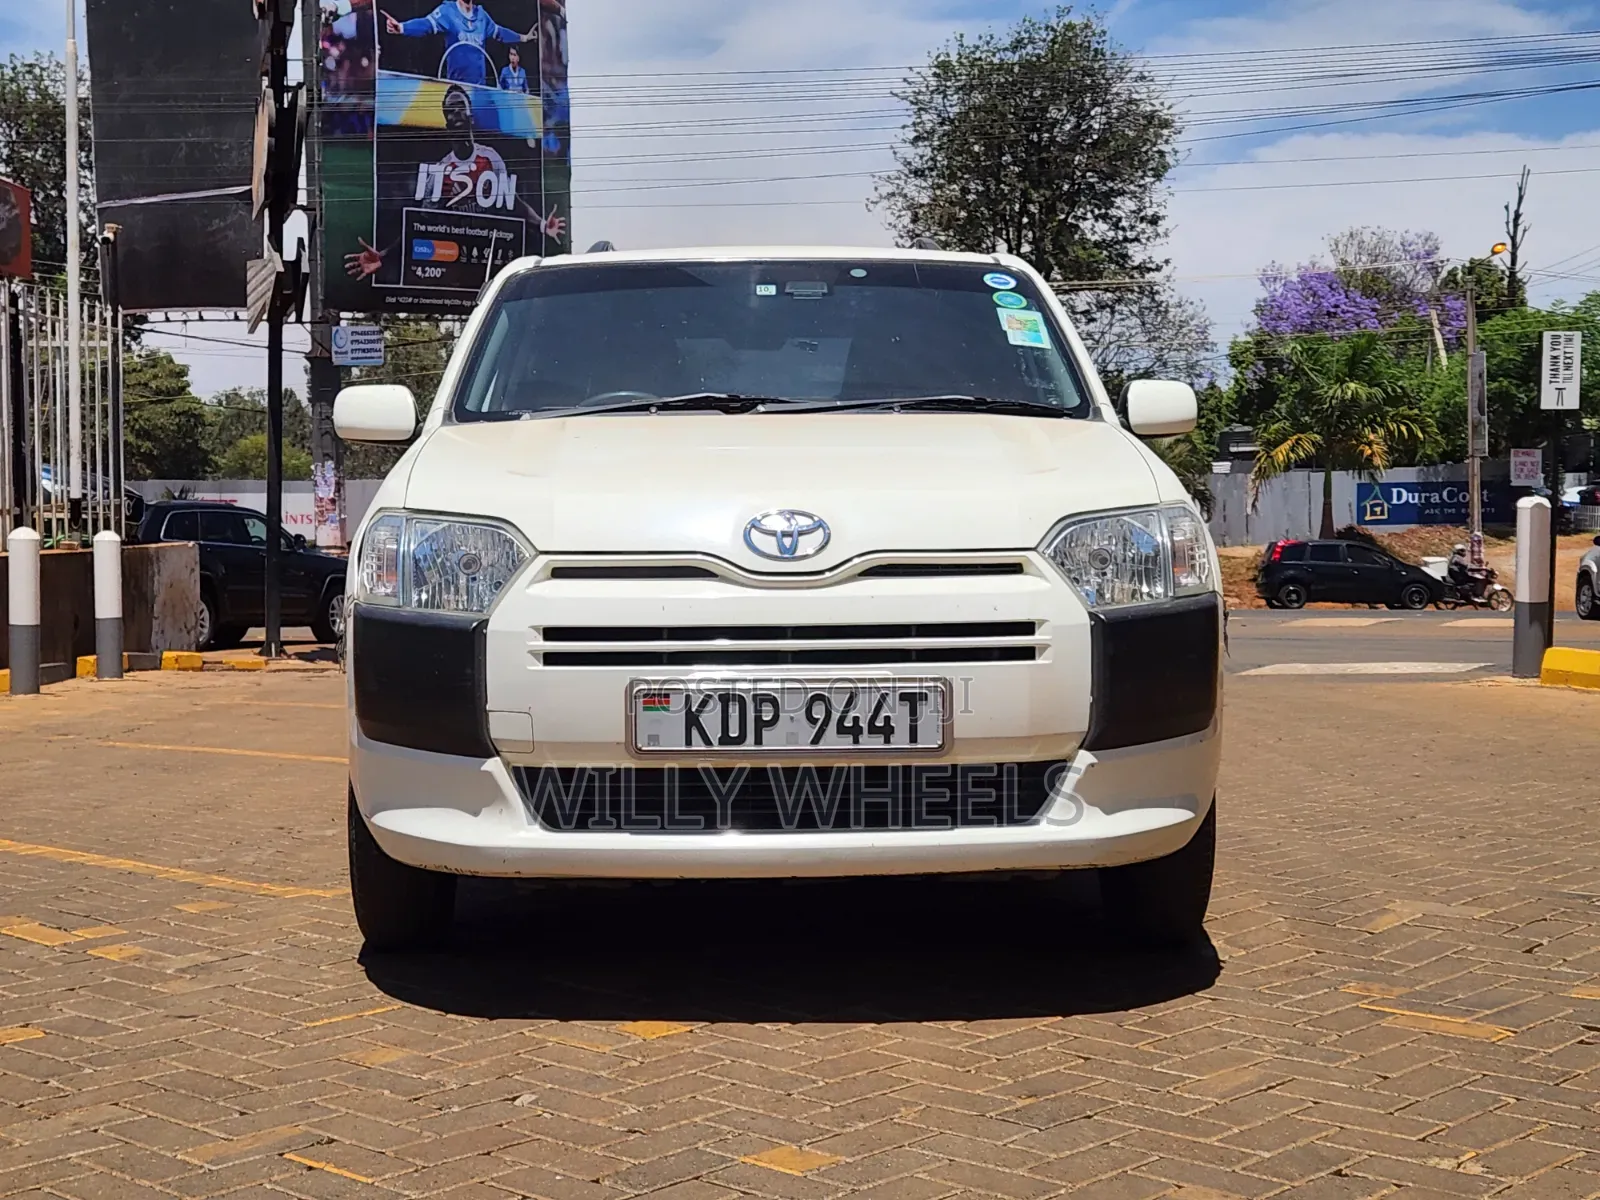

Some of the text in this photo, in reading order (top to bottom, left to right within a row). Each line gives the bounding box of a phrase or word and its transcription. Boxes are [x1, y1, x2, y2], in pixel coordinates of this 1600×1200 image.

[415, 163, 517, 210] IT'S ON
[413, 222, 514, 241] The world's best football pckage
[416, 266, 441, 278] 4,200
[1549, 334, 1562, 385] THANK YOU
[1563, 351, 1574, 371] NEXT
[1391, 486, 1489, 504] DuraCot
[684, 691, 781, 746] KDP
[804, 691, 929, 746] 944T
